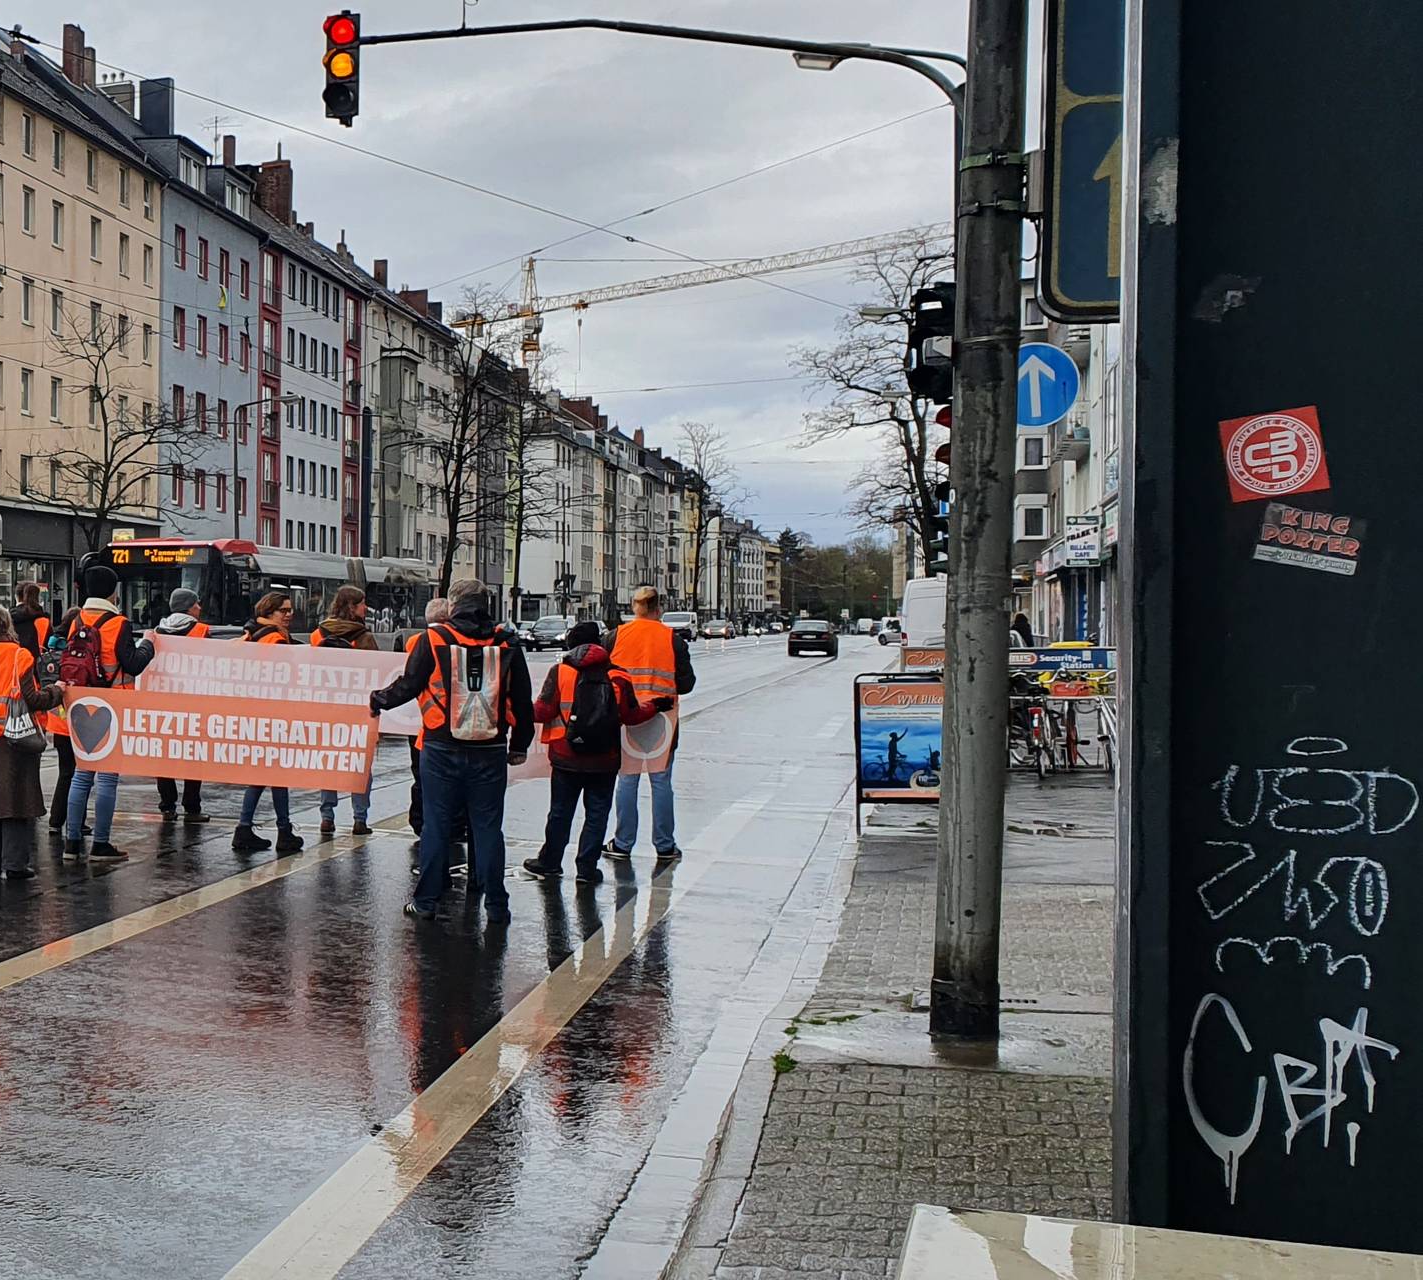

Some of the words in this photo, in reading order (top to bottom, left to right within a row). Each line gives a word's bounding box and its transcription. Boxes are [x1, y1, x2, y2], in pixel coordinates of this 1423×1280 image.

[1281, 507, 1351, 535] KING
[1261, 523, 1360, 556] PORTER
[112, 549, 129, 564] 721
[1039, 654, 1082, 663] Security-
[1060, 661, 1094, 669] Station
[122, 708, 201, 736] LETZTE
[207, 714, 369, 749] GENERATION
[120, 735, 163, 758] VOR
[168, 739, 209, 762] DEN
[213, 742, 366, 773] KIPPPUNKTEN
